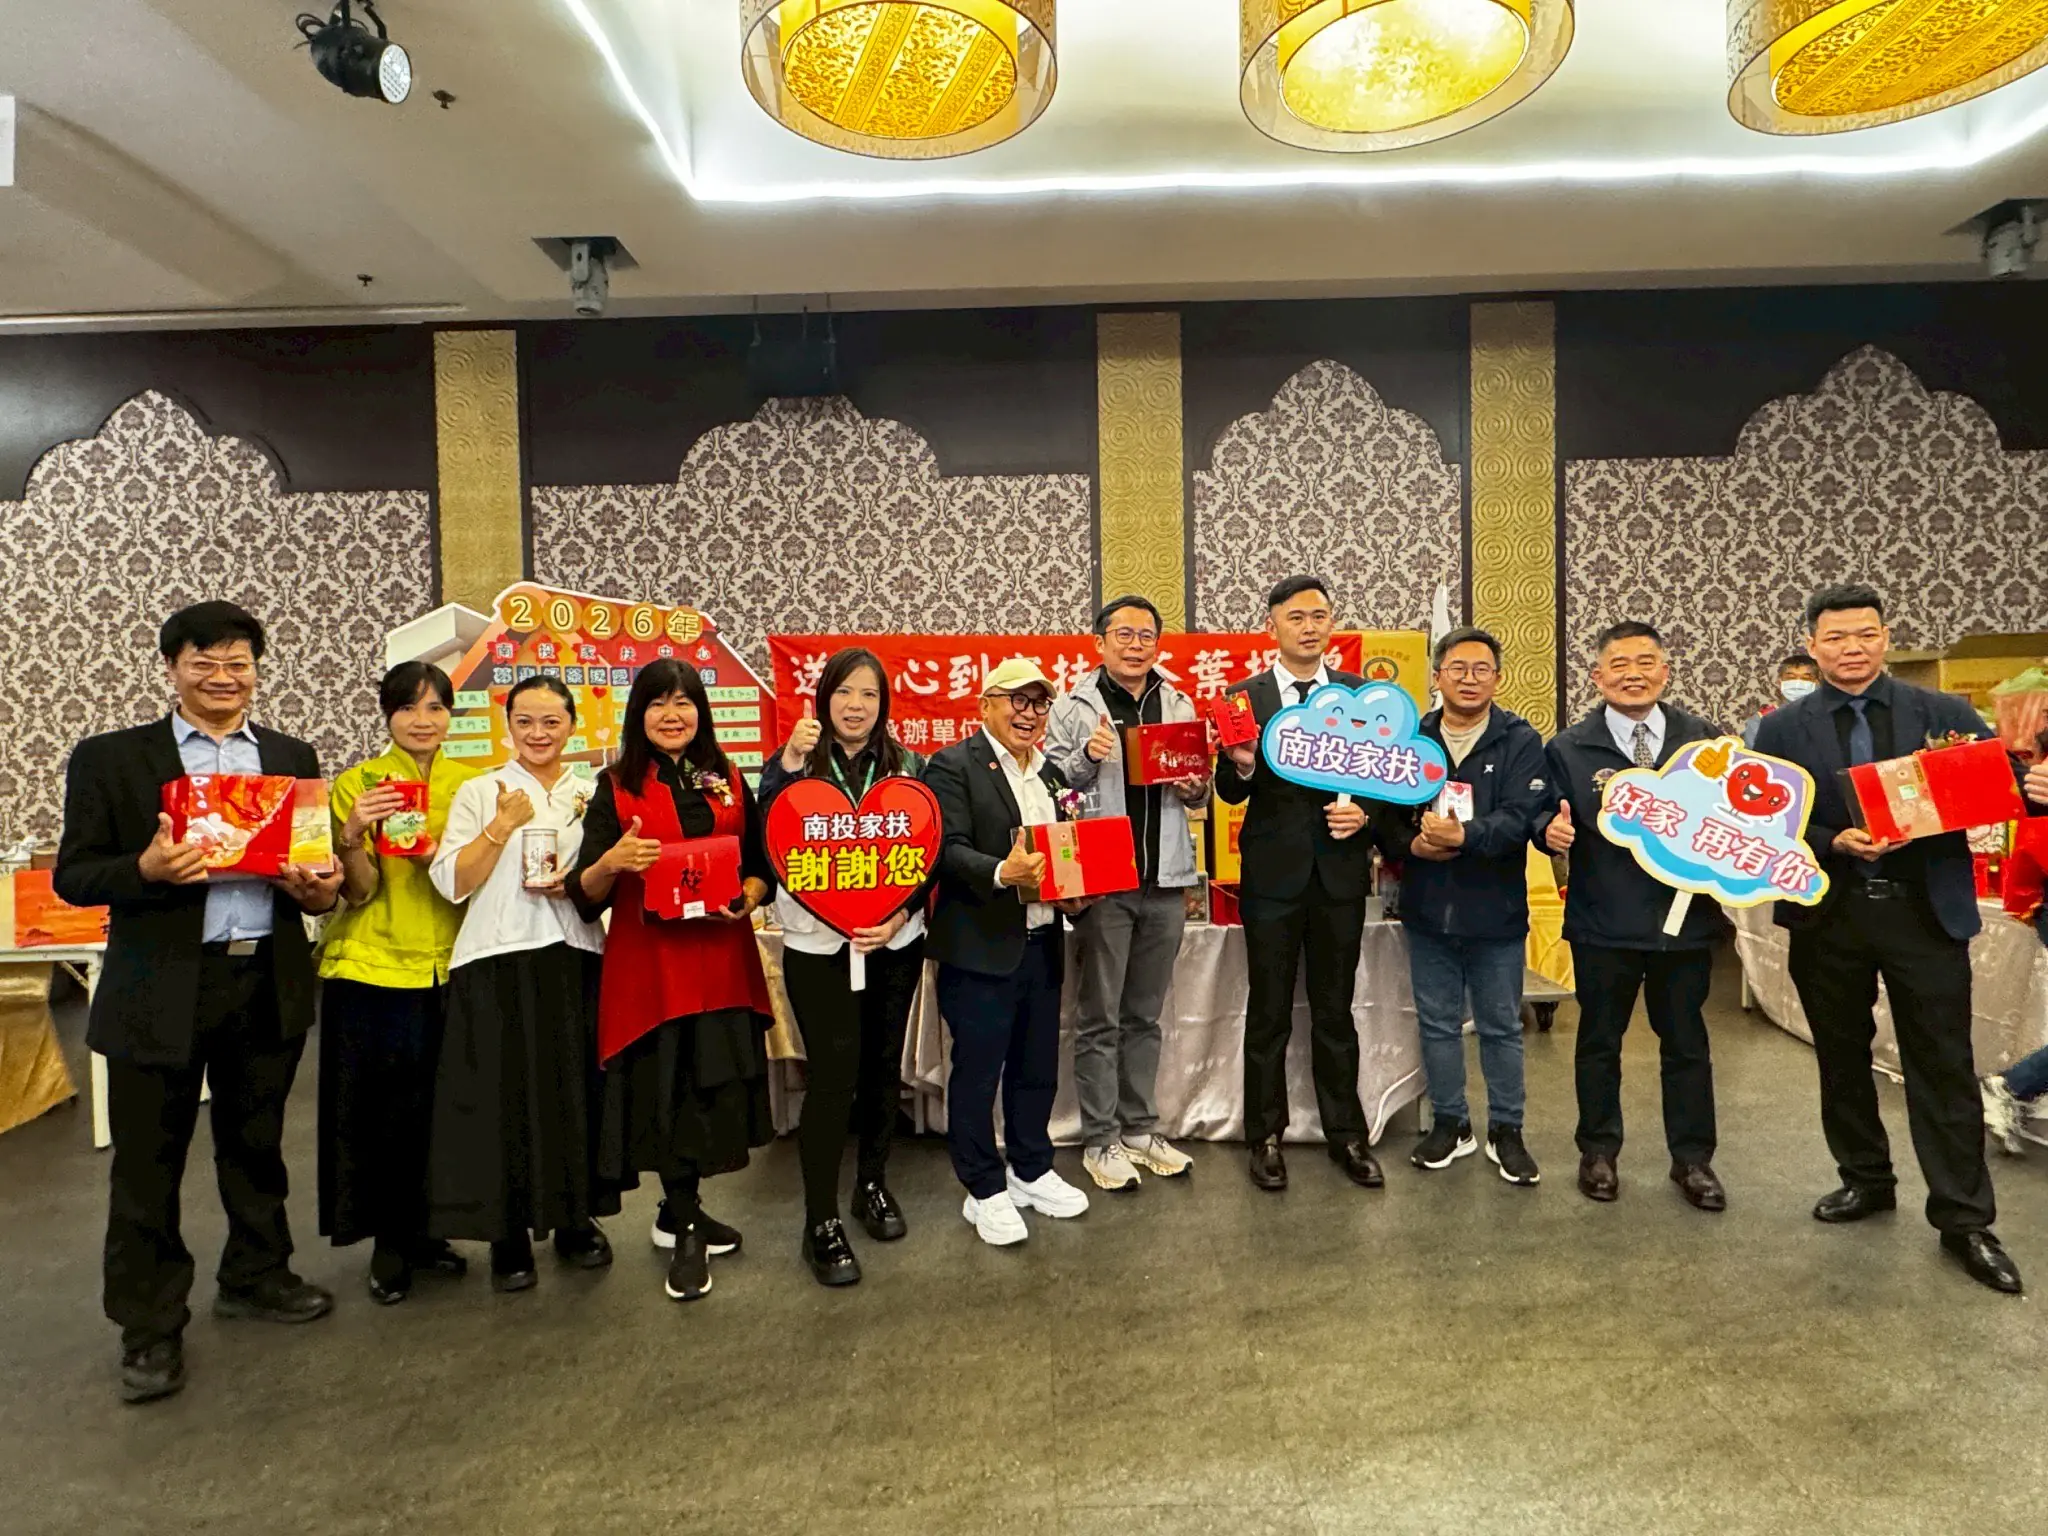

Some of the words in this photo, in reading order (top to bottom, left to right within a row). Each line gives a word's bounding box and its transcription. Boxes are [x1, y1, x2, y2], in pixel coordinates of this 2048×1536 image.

[510, 596, 701, 642] 2026年
[495, 642, 711, 662] 南投家扶中心
[1279, 728, 1419, 787] 南投家扶
[803, 811, 912, 841] 南投家扶
[1605, 782, 1687, 837] 好家
[1693, 817, 1816, 893] 再有你
[786, 844, 927, 892] 謝謝您
